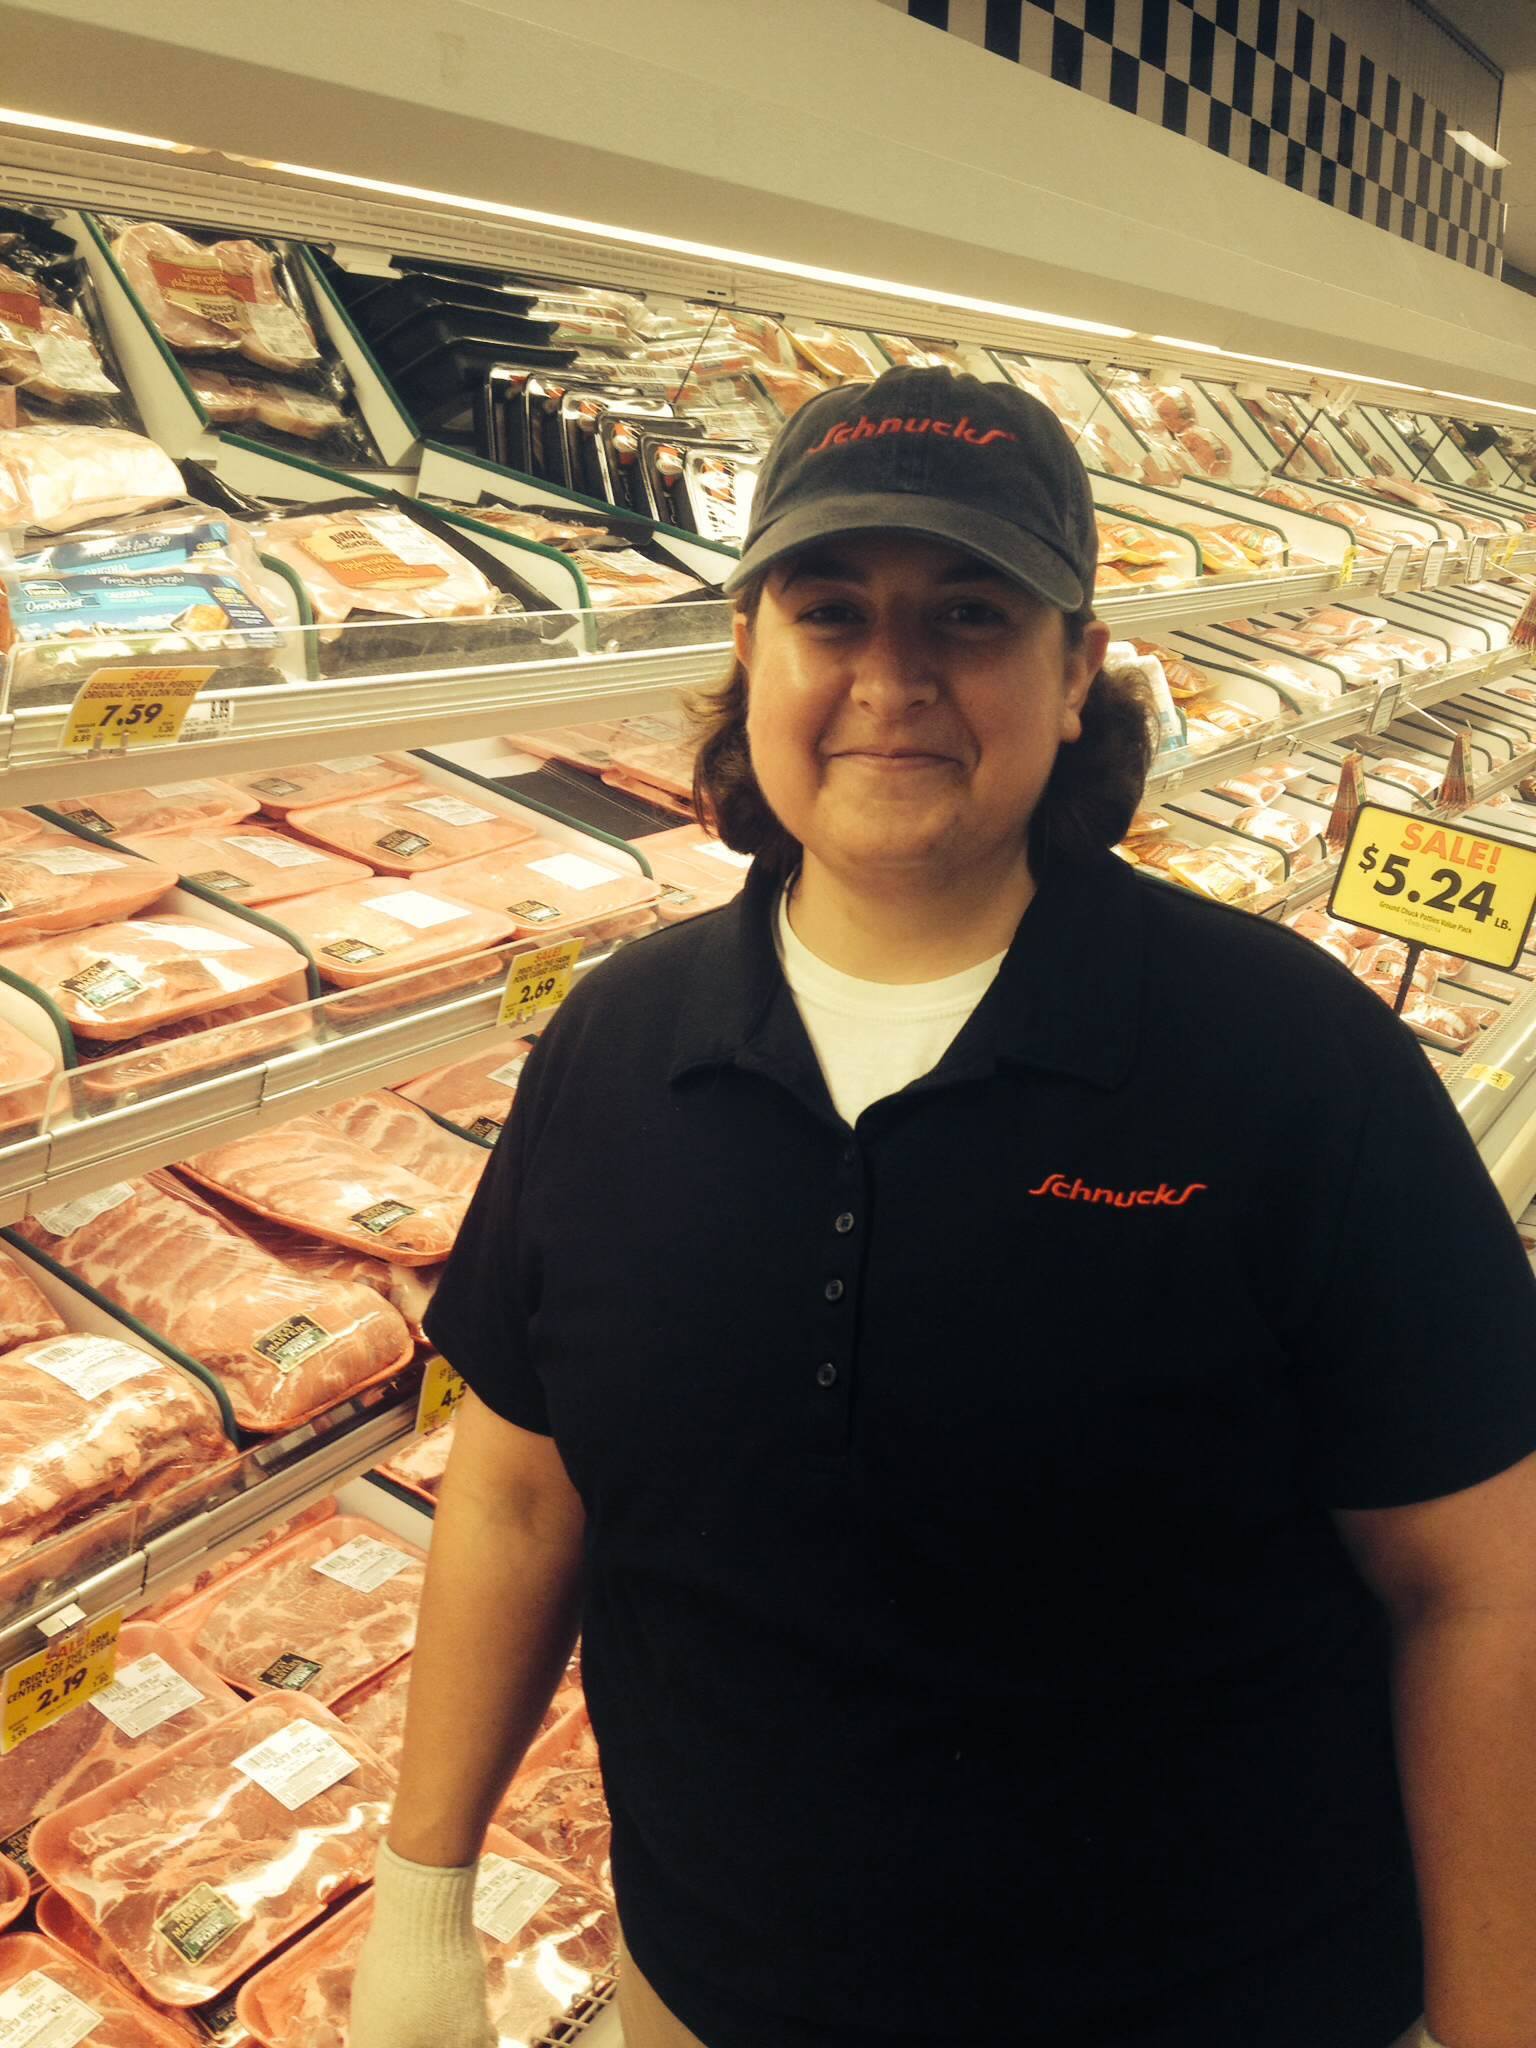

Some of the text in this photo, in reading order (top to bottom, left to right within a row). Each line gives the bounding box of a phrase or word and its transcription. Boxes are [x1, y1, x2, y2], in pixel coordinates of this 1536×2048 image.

[807, 415, 1019, 456] Schnucks
[131, 670, 183, 681] SALE!
[99, 703, 163, 727] 7.59
[1400, 822, 1502, 874] SALE!
[1358, 843, 1512, 931] $5.24 LB.
[520, 978, 555, 1003] 2.69
[1028, 1173, 1208, 1208] Schnucks
[441, 1381, 467, 1406] 4.5
[36, 1667, 88, 1713] 2.19
[172, 1902, 217, 1938] MASTERS
[193, 1920, 225, 1947] PORK
